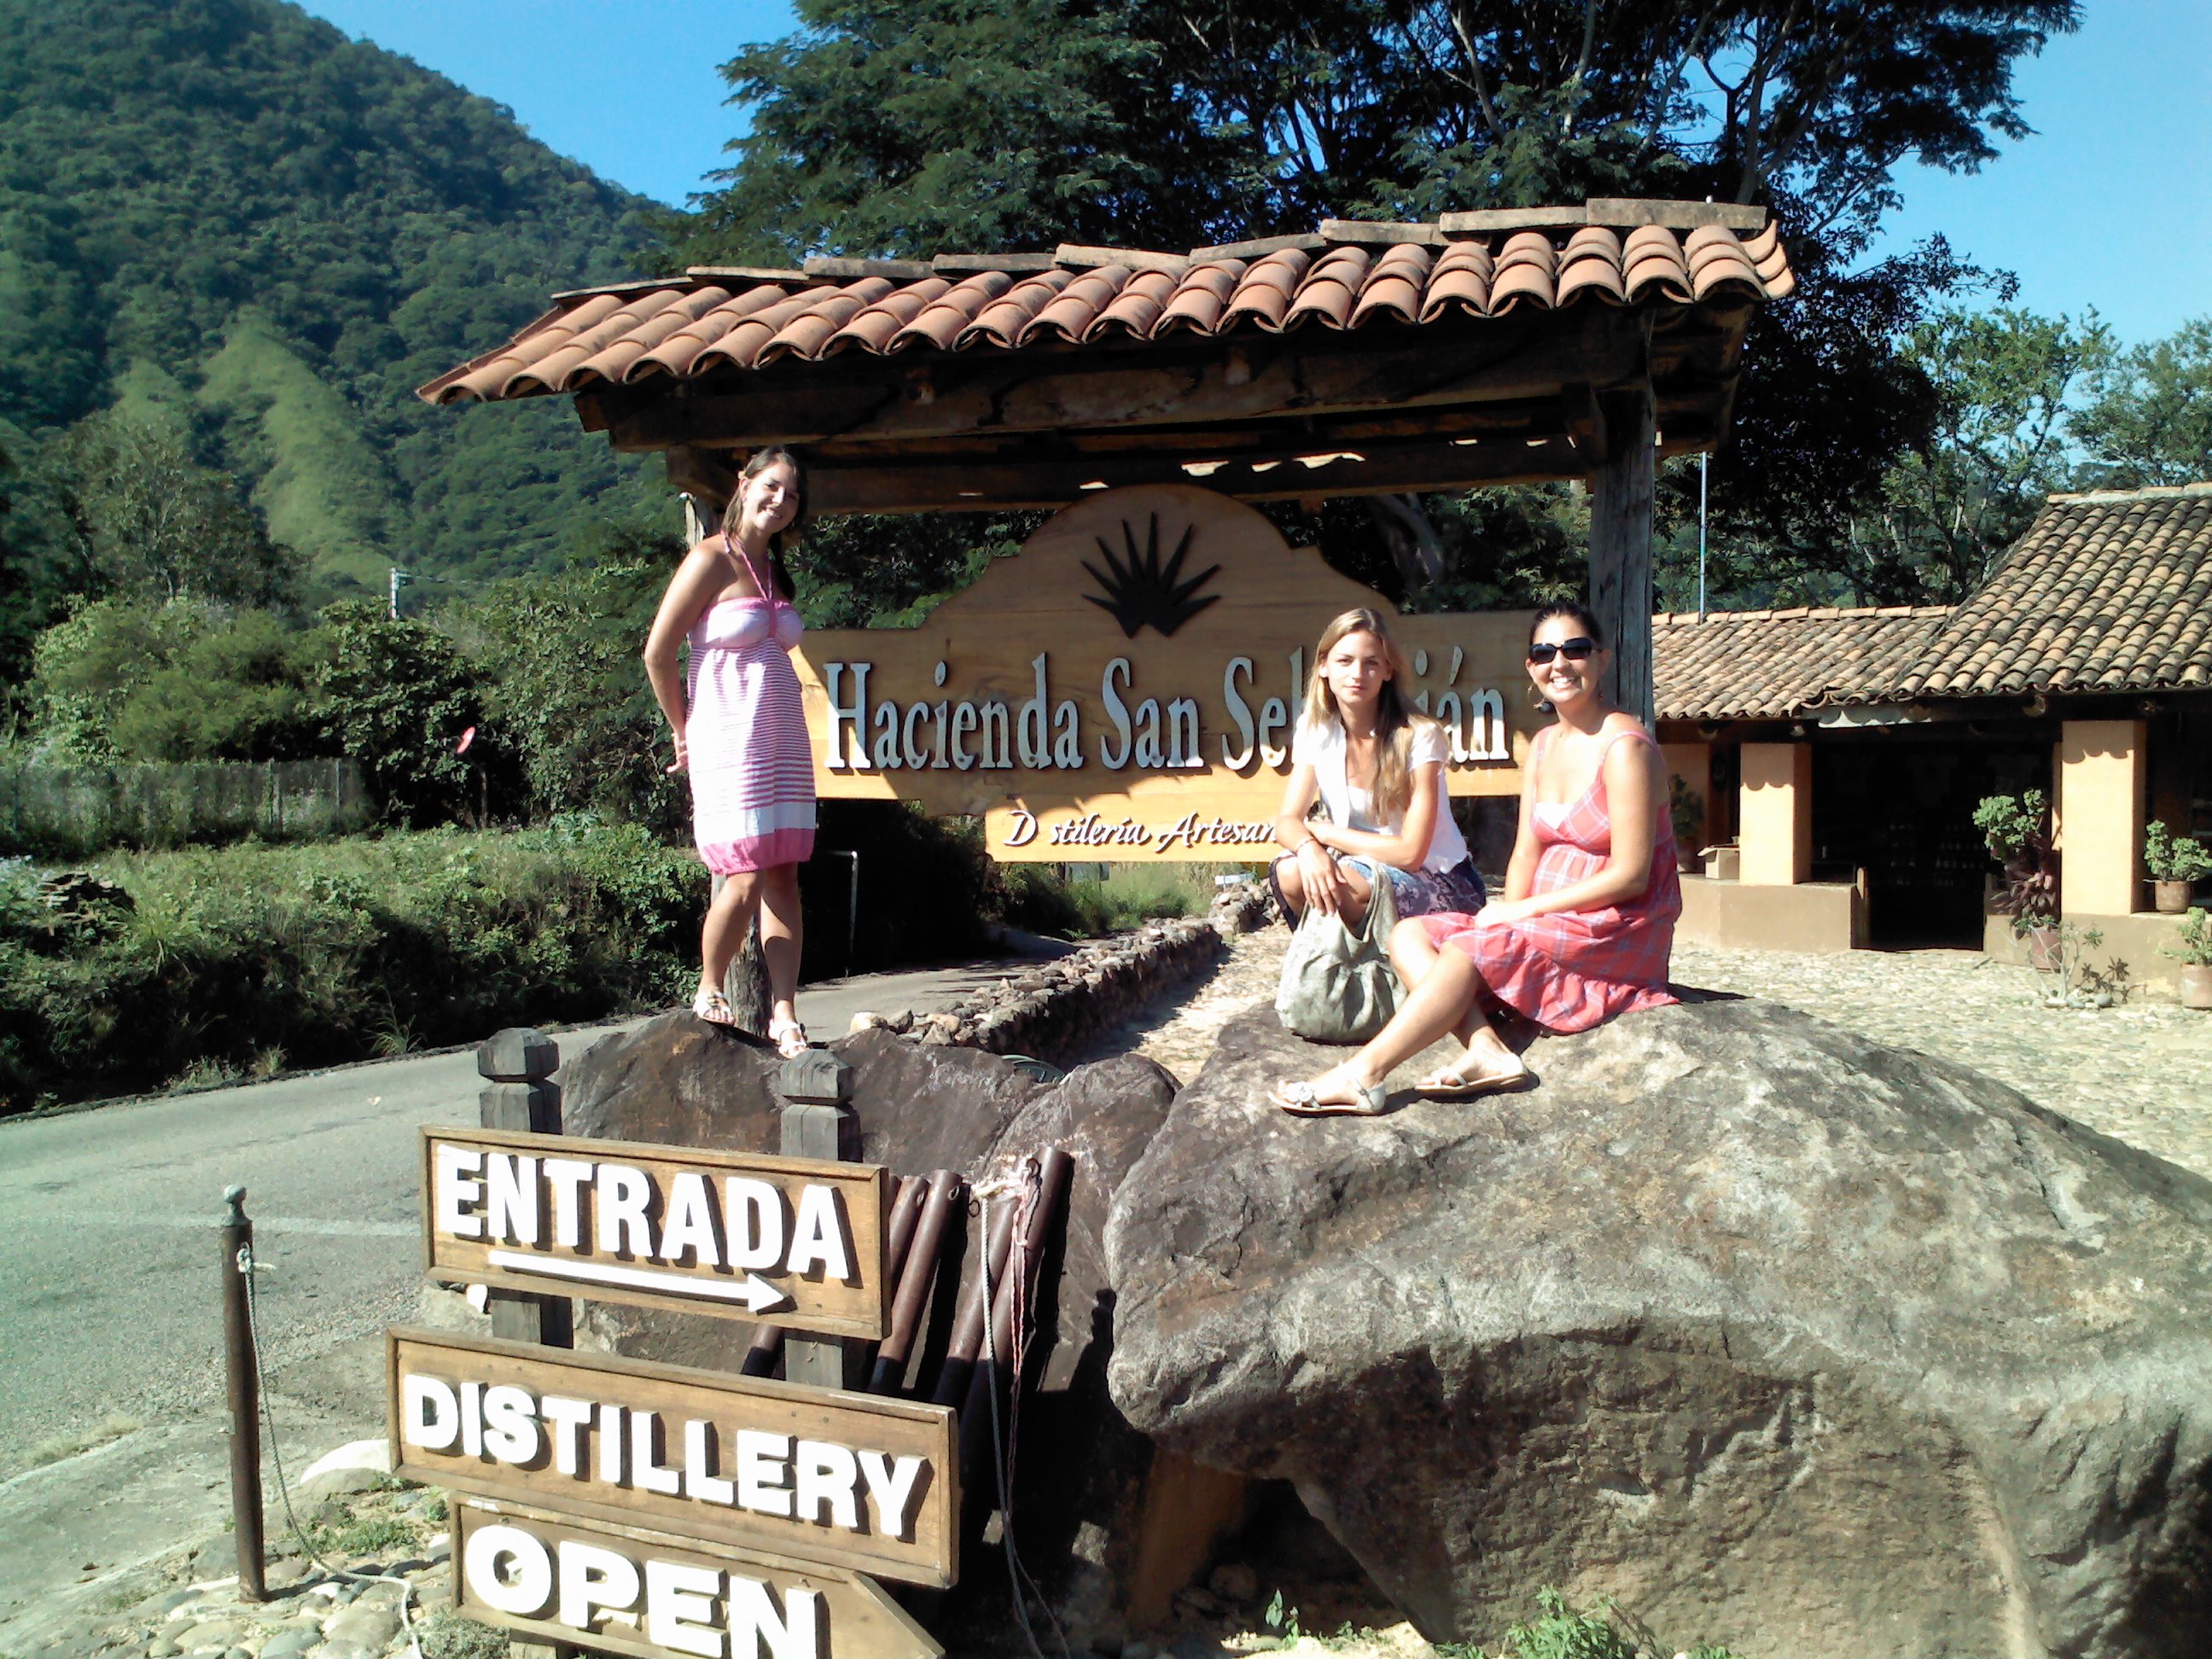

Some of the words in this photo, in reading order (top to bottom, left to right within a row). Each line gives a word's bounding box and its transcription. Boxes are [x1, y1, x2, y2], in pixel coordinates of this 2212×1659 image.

[823, 651, 1085, 771] Hacienda
[1099, 656, 1205, 771] San
[1221, 645, 1511, 771] Seián
[1002, 809, 1152, 847] Dstilería
[1154, 811, 1278, 853] Artesan
[437, 1143, 850, 1281] ENTRADA
[403, 1372, 927, 1538] DISTILLERY
[464, 1524, 818, 1659] OPEN
